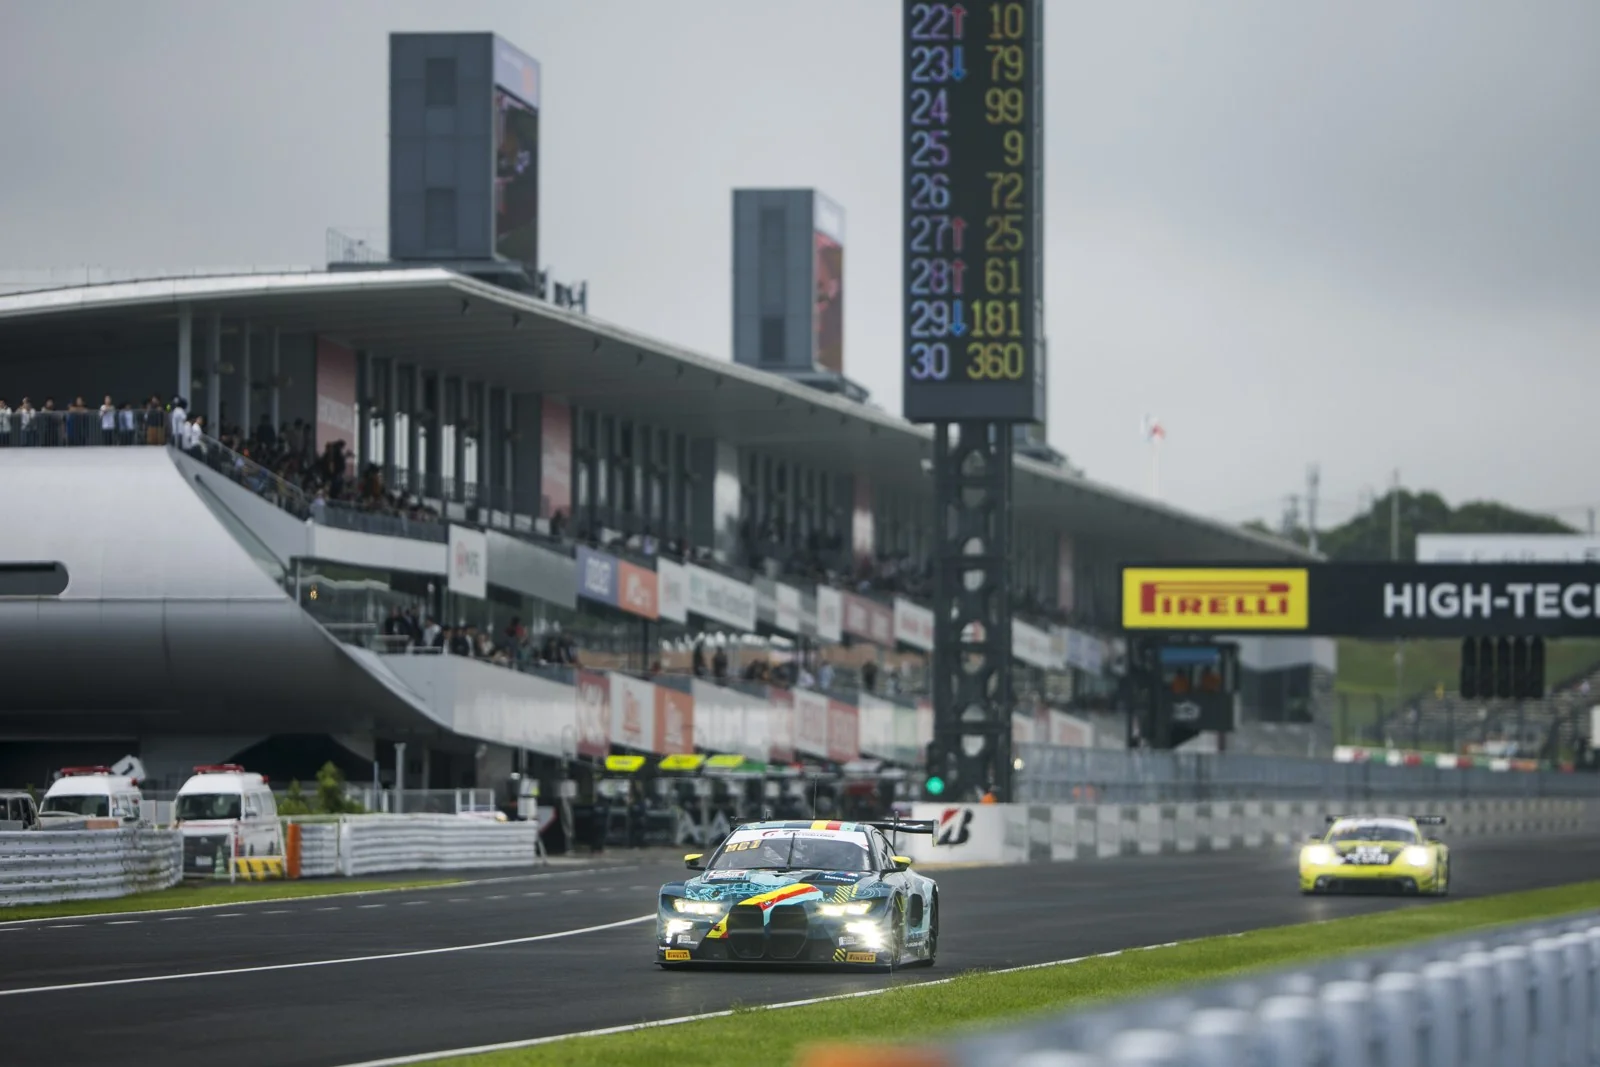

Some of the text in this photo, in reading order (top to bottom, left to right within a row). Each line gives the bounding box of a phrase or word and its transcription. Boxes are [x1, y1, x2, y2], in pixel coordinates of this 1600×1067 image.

[911, 3, 1023, 39] 22 10
[911, 45, 1023, 82] 23 79
[911, 88, 1023, 124] 24 99
[911, 130, 1023, 166] 25 9
[911, 172, 1023, 209] 26 72
[910, 215, 1023, 252] 27 25
[910, 258, 1021, 294] 28 61
[910, 300, 1021, 336] 29 181
[910, 342, 1023, 379] 30 360
[1140, 581, 1290, 614] PIRELLI
[1383, 582, 1600, 618] HIGH-TEC
